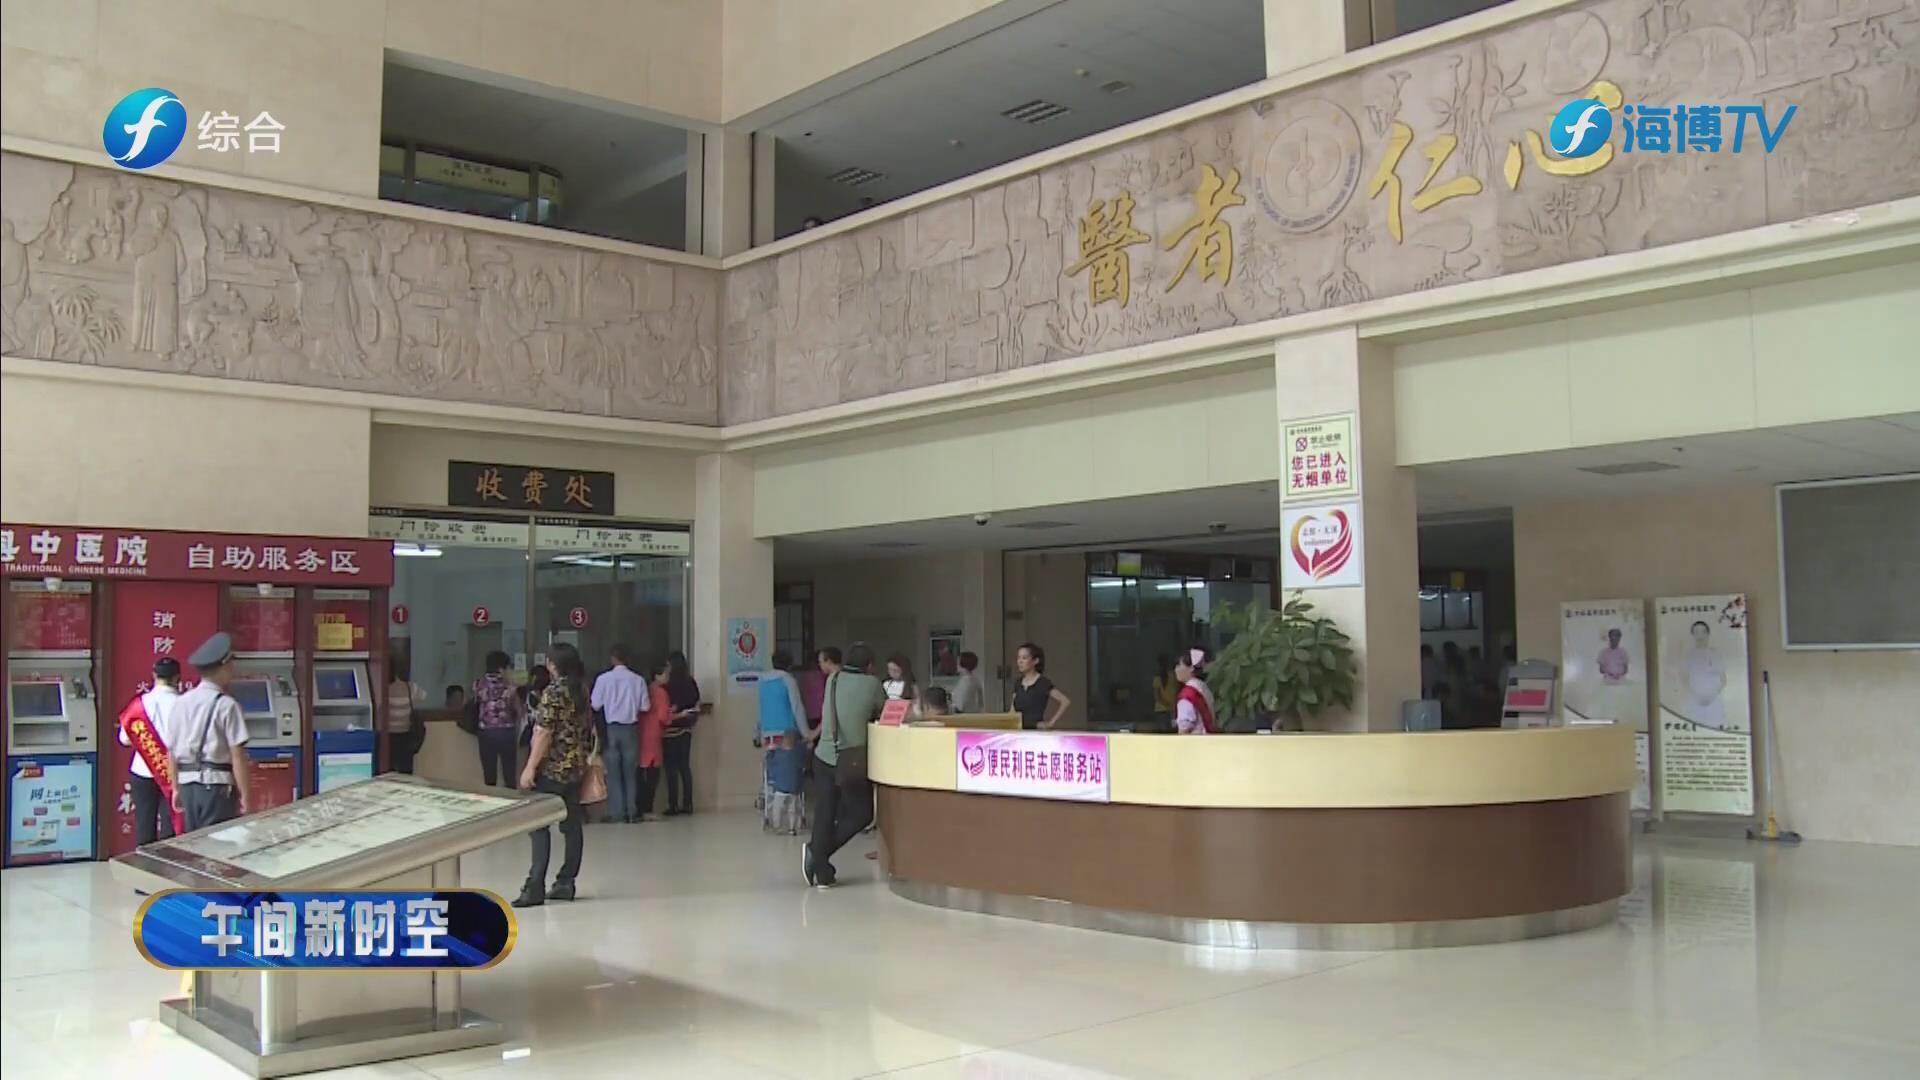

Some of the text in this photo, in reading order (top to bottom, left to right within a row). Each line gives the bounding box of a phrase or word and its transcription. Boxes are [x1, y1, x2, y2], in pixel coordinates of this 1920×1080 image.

[1292, 451, 1347, 470] 您已进入
[475, 467, 594, 508] 收费处
[1292, 467, 1348, 489] 无烟单位
[400, 520, 488, 535] 门诊收费
[576, 529, 653, 543] 门诊收费
[188, 543, 361, 574] 自助服务区
[5, 564, 147, 576] TRADITIONAL CHINESE MEDICINE
[153, 611, 176, 656] 消防
[988, 748, 1103, 784] 便民利民志愿服务站
